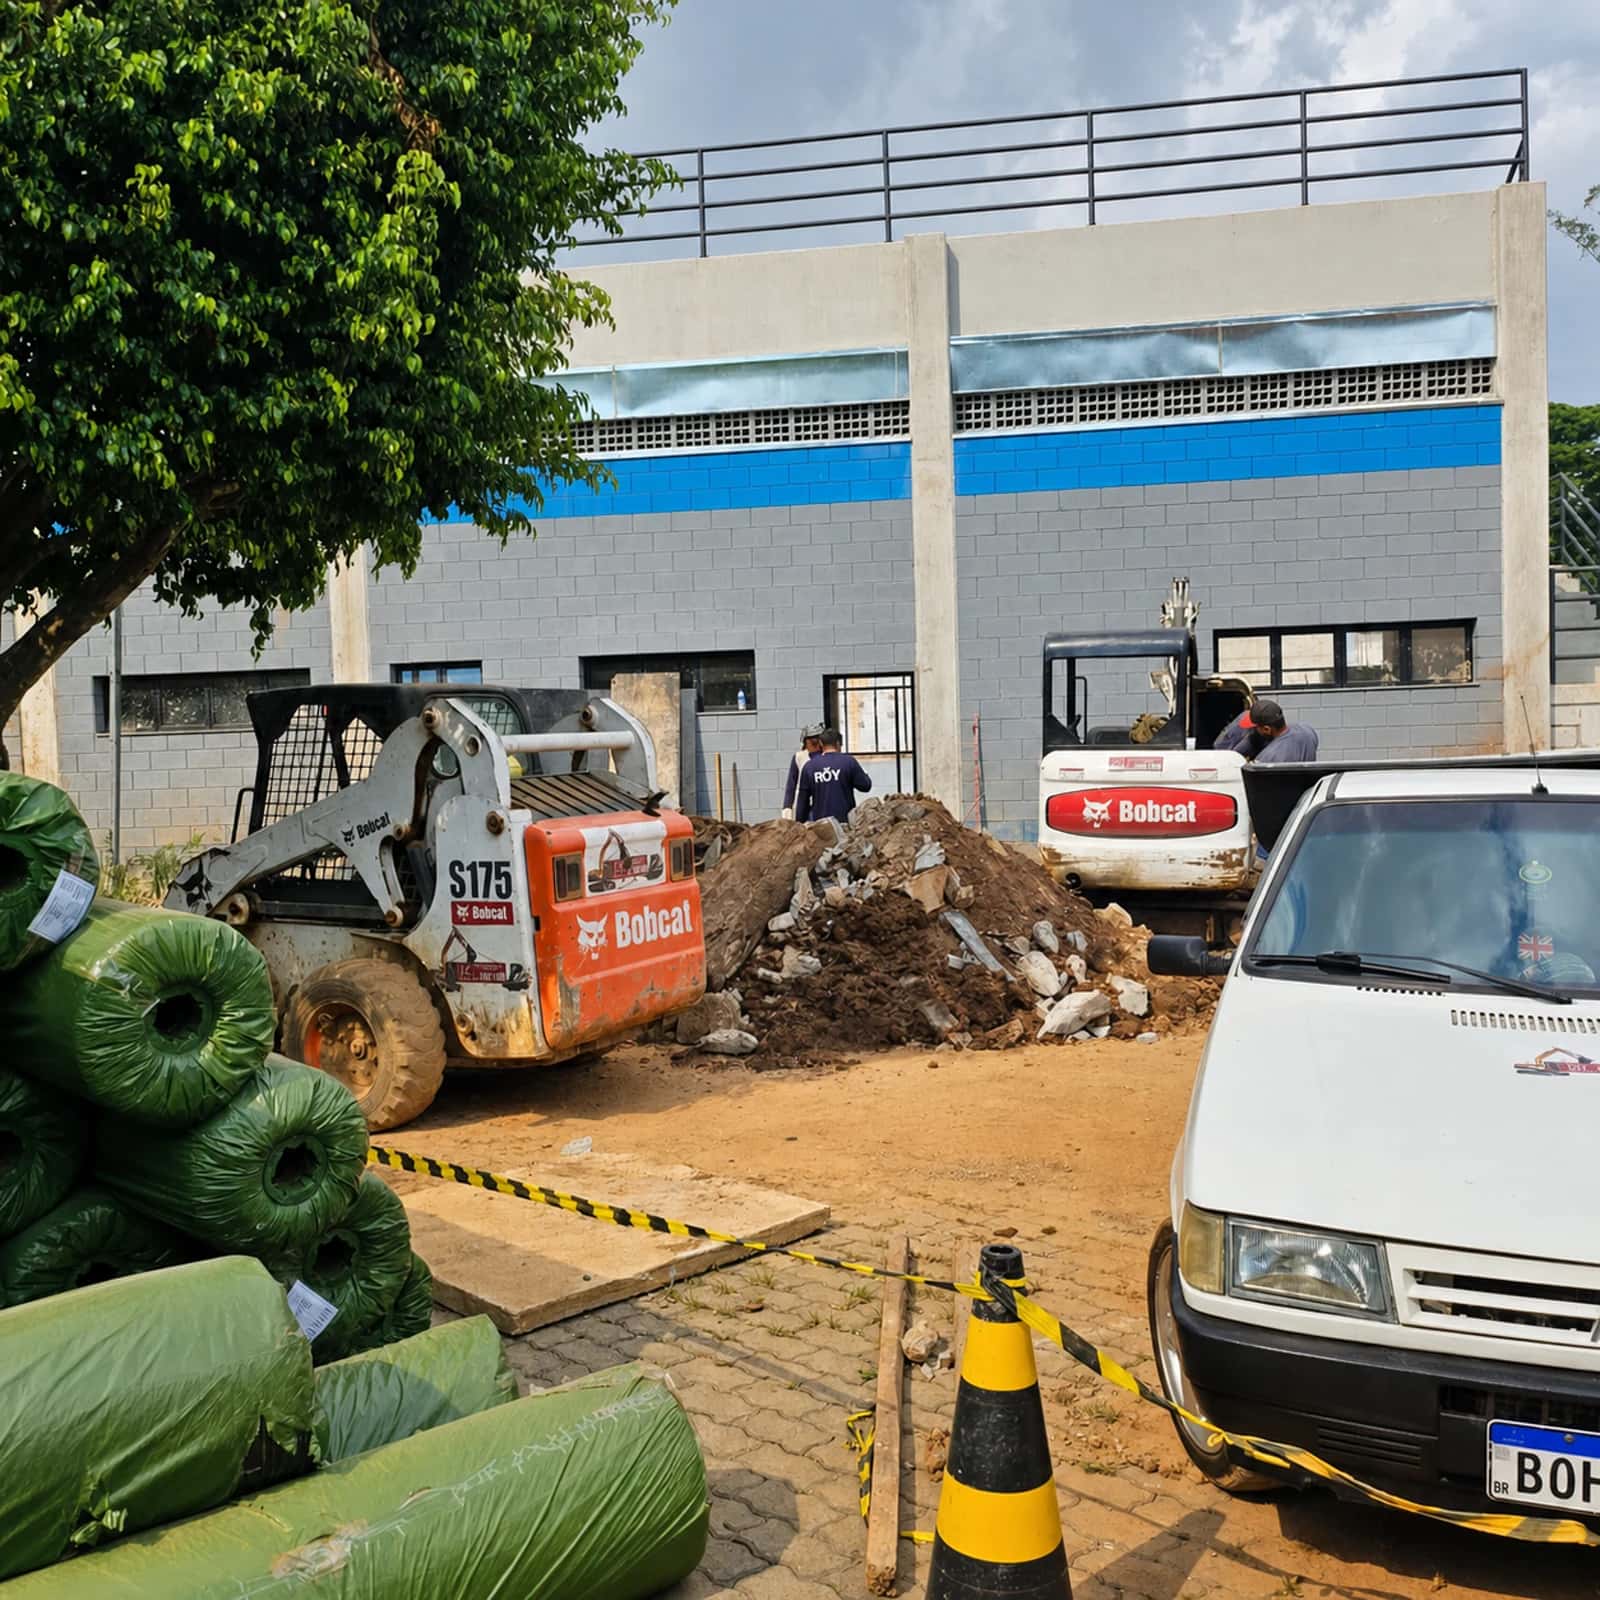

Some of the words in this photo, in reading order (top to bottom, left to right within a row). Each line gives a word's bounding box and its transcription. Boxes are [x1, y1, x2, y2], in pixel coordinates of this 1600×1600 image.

[1119, 799, 1197, 823] Bobcat
[356, 811, 391, 839] Bobcat
[449, 859, 513, 899] S175
[472, 905, 507, 921] Bobcat
[615, 900, 693, 949] Bobcat
[1493, 1481, 1509, 1494] BR
